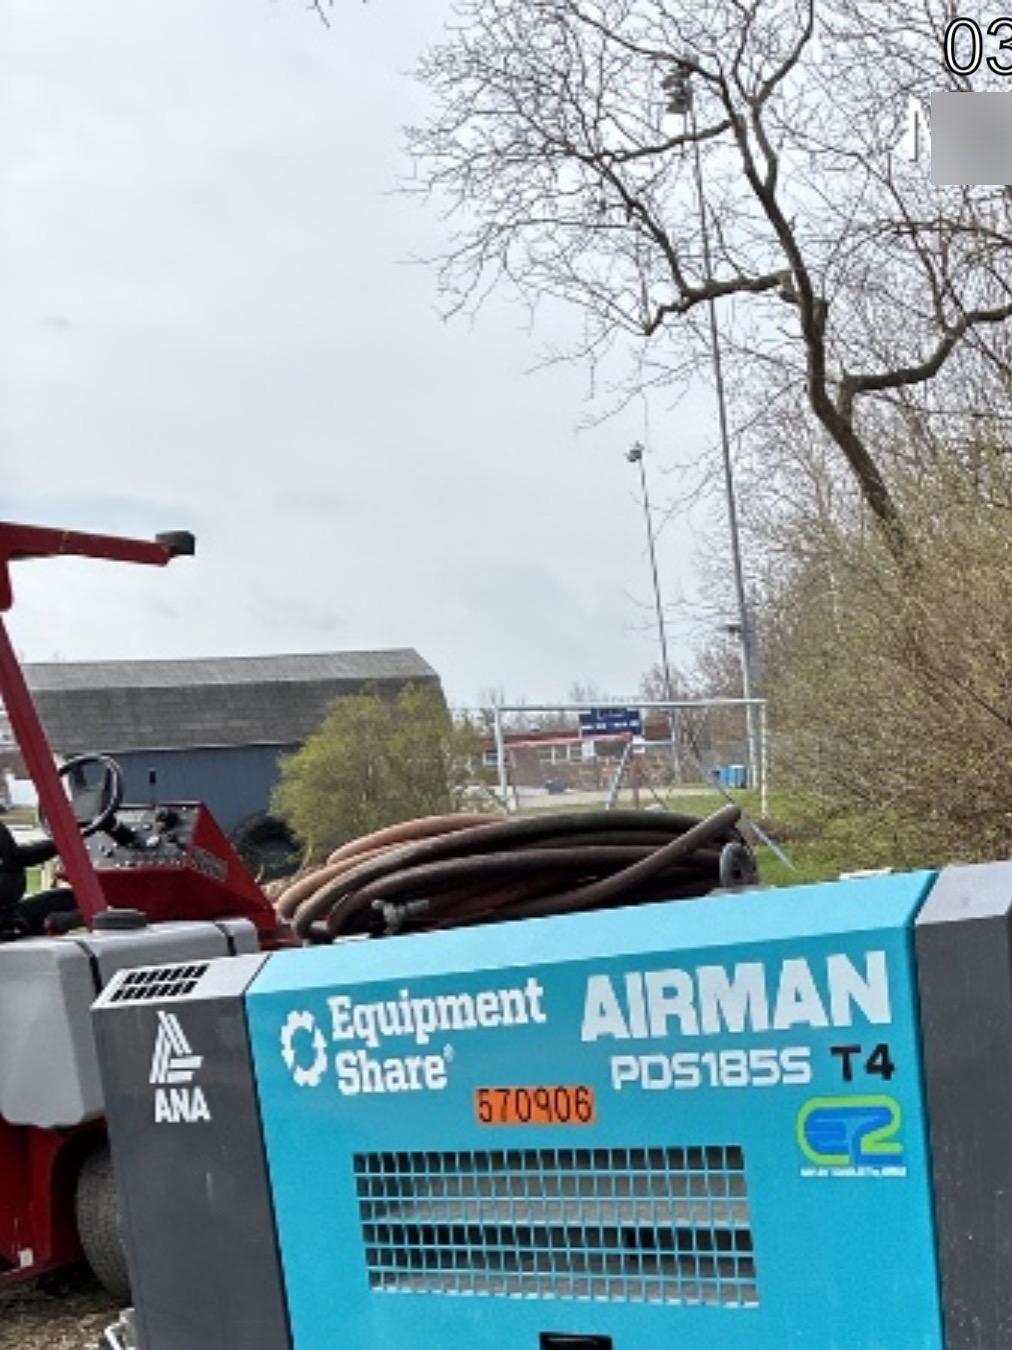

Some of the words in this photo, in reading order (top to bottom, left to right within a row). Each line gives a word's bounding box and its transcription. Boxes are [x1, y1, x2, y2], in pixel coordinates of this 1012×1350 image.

[327, 978, 546, 1044] Equipment
[581, 950, 892, 1042] AIRMAN
[611, 1047, 811, 1090] PDS185S
[830, 1043, 895, 1081] T4
[154, 1087, 210, 1123] ANA
[478, 1087, 592, 1124] 570906
